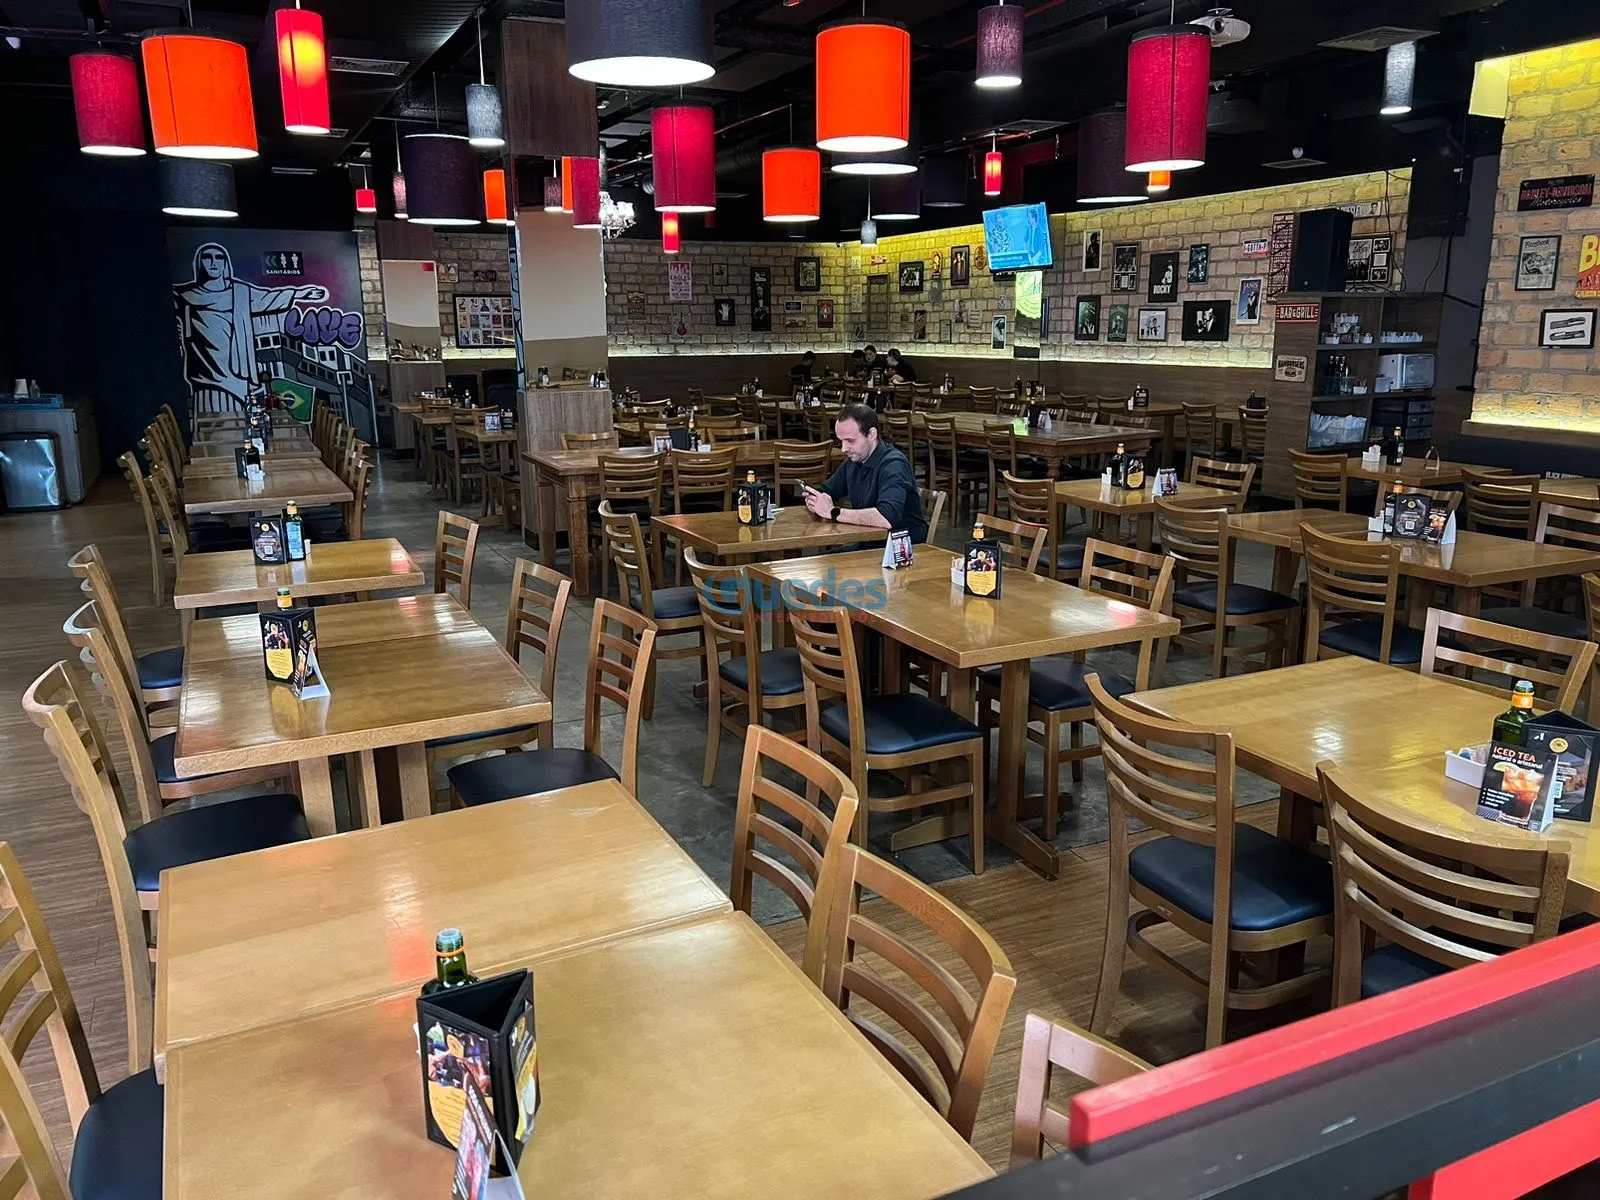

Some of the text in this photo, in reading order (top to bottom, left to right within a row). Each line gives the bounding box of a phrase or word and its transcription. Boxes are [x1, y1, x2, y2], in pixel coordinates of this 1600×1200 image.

[1521, 184, 1591, 200] HARLEY-DAVIDSON
[1153, 284, 1171, 294] ROCKY
[285, 306, 362, 348] LOVE
[1492, 754, 1512, 762] natural
[1493, 746, 1537, 763] ICED TEA
